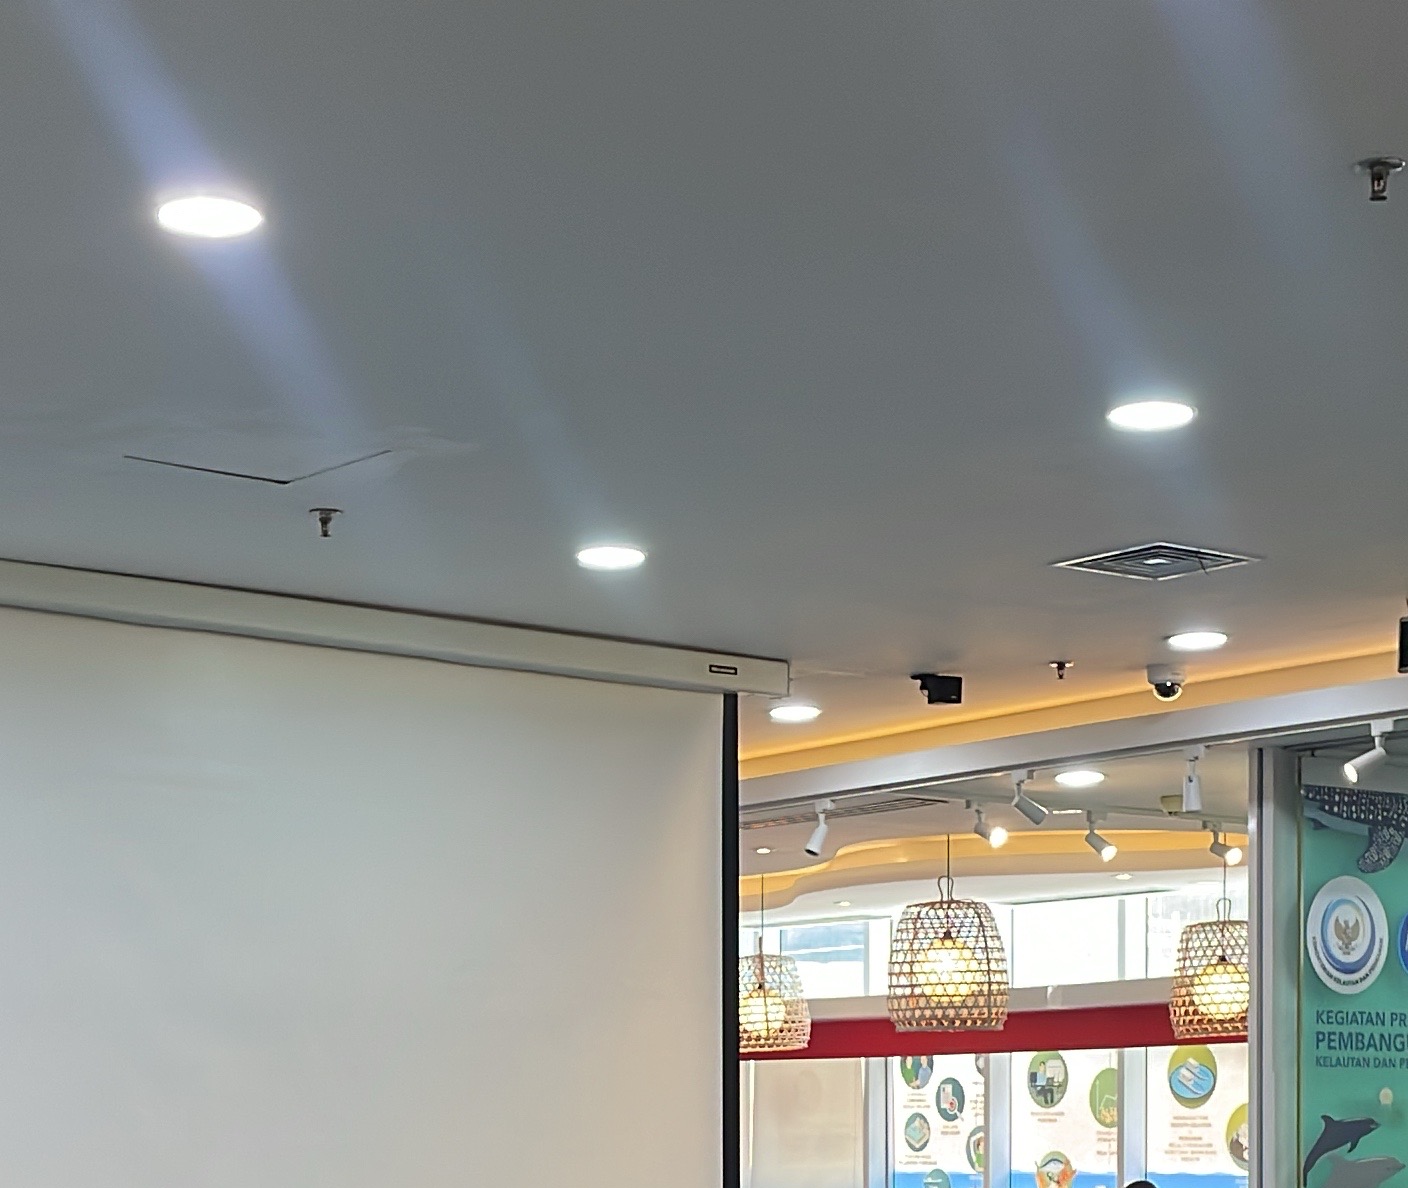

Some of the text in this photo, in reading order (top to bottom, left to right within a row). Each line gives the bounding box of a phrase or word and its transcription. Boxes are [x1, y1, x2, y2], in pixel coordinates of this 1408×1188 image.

[1315, 1010, 1386, 1027] KEGIATAN
[1315, 1055, 1371, 1068] KELAUTAN
[1373, 1057, 1396, 1069] DAN
